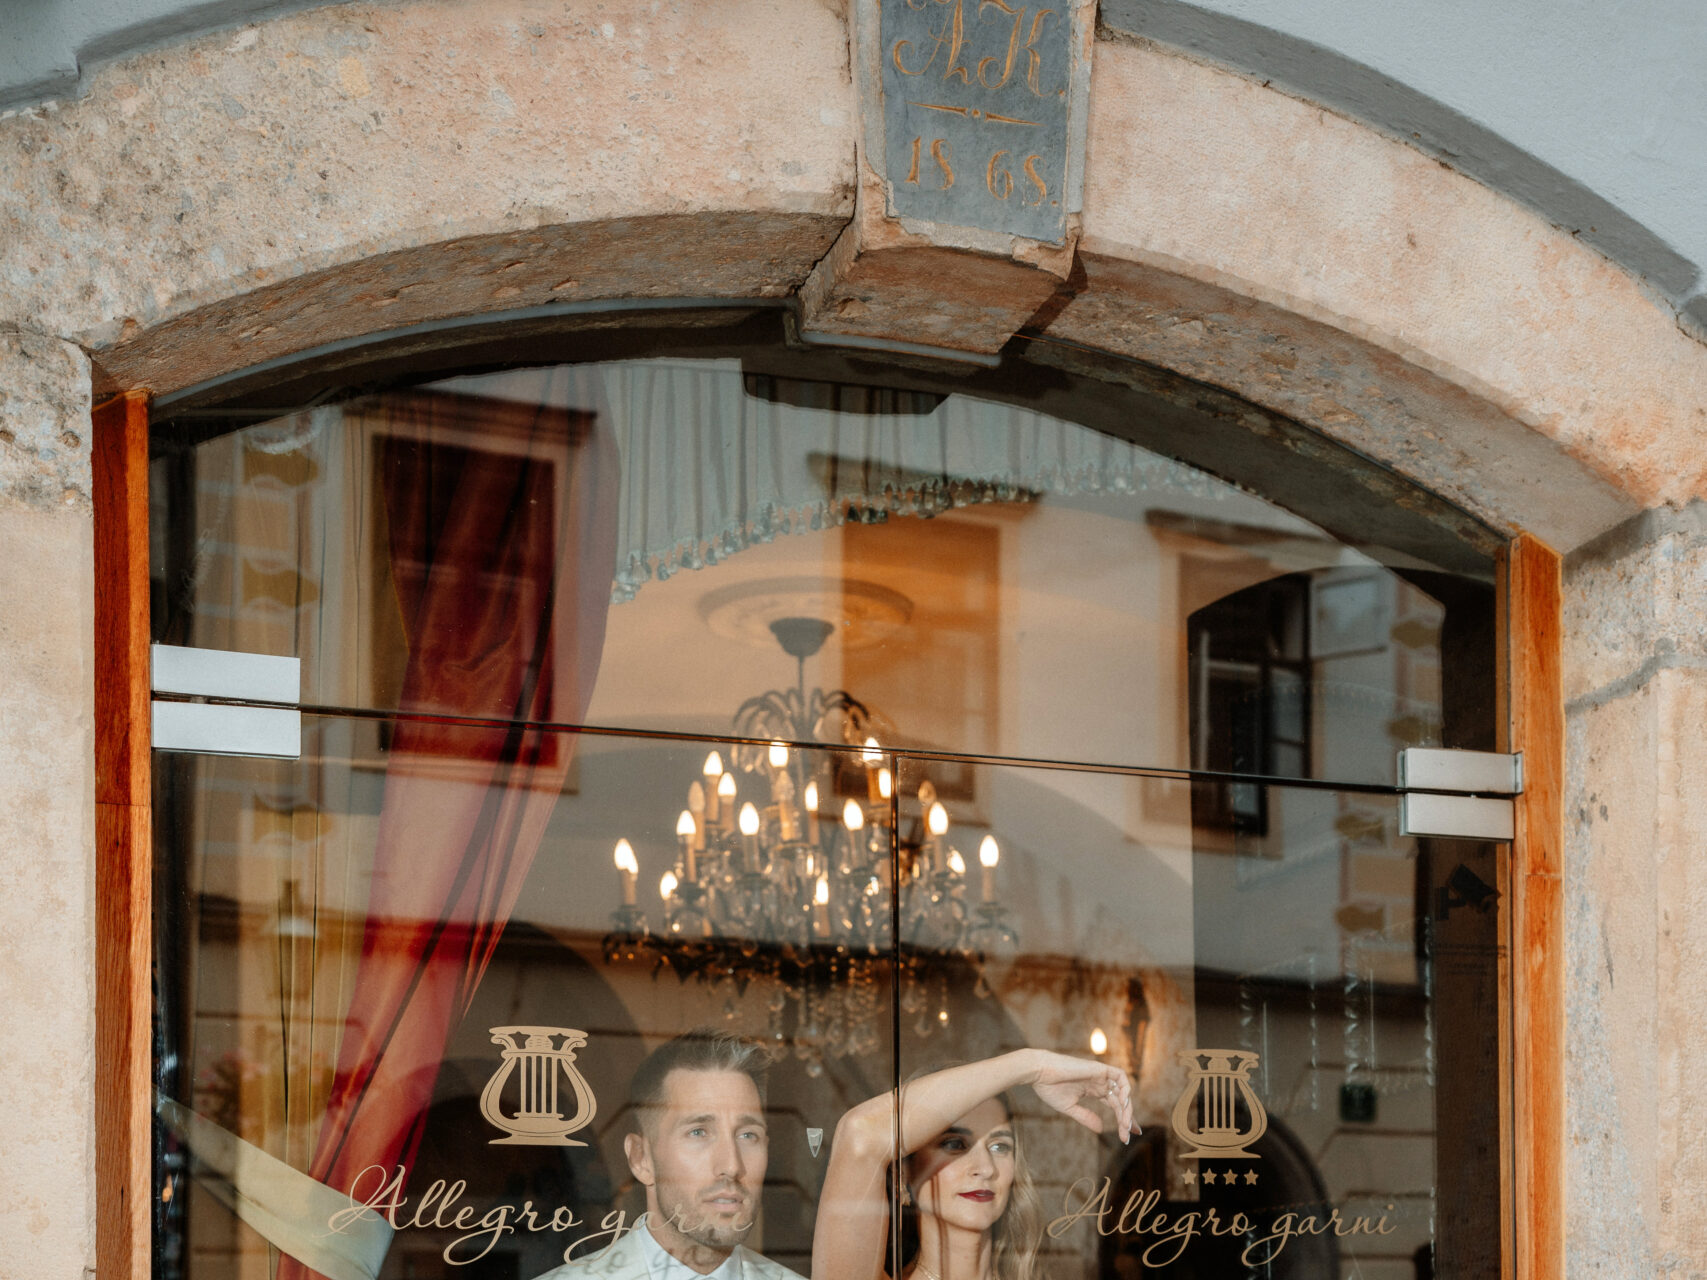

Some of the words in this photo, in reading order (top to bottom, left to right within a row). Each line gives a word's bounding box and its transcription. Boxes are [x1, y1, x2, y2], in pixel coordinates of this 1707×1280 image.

[311, 1164, 583, 1266] Allegro
[563, 1194, 754, 1266] garni
[1046, 1176, 1258, 1268] Allegro
[1241, 1204, 1398, 1268] garni
